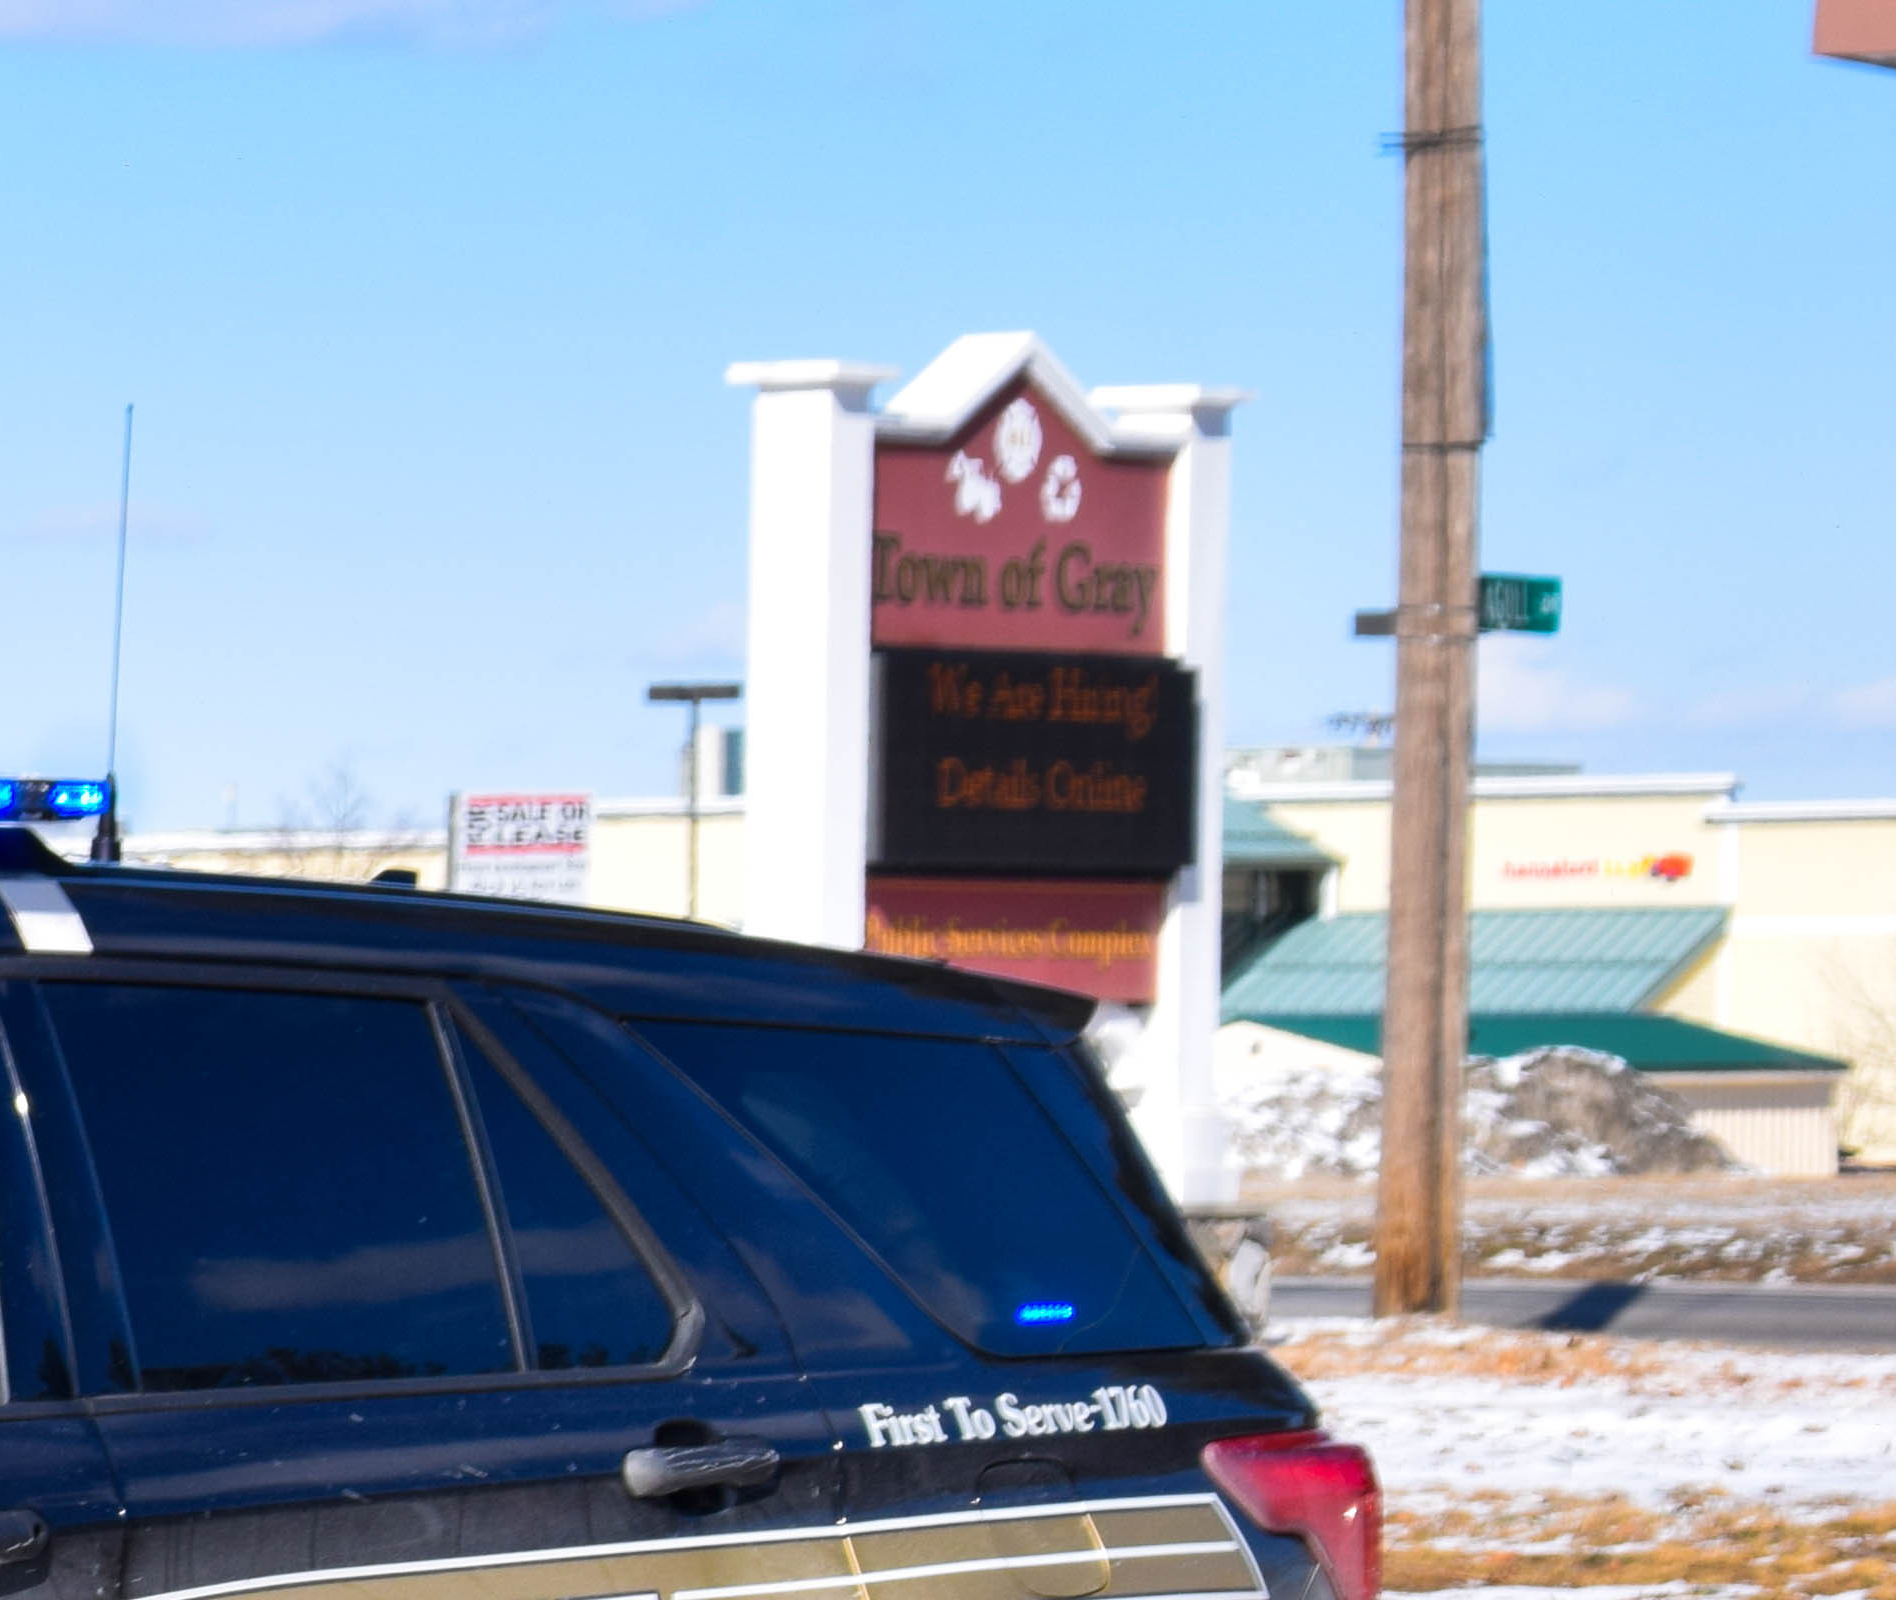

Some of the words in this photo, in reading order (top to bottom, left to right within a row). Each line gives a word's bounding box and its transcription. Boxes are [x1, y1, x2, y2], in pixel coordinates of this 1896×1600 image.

[871, 530, 989, 609] Town
[999, 536, 1047, 611] of
[1056, 540, 1159, 640] Gray
[497, 802, 553, 822] SALE
[1046, 760, 1149, 812] Online
[496, 827, 585, 845] LEASE
[859, 1402, 949, 1447] First
[942, 1396, 997, 1440] To
[995, 1383, 1167, 1438] Serve-1760
